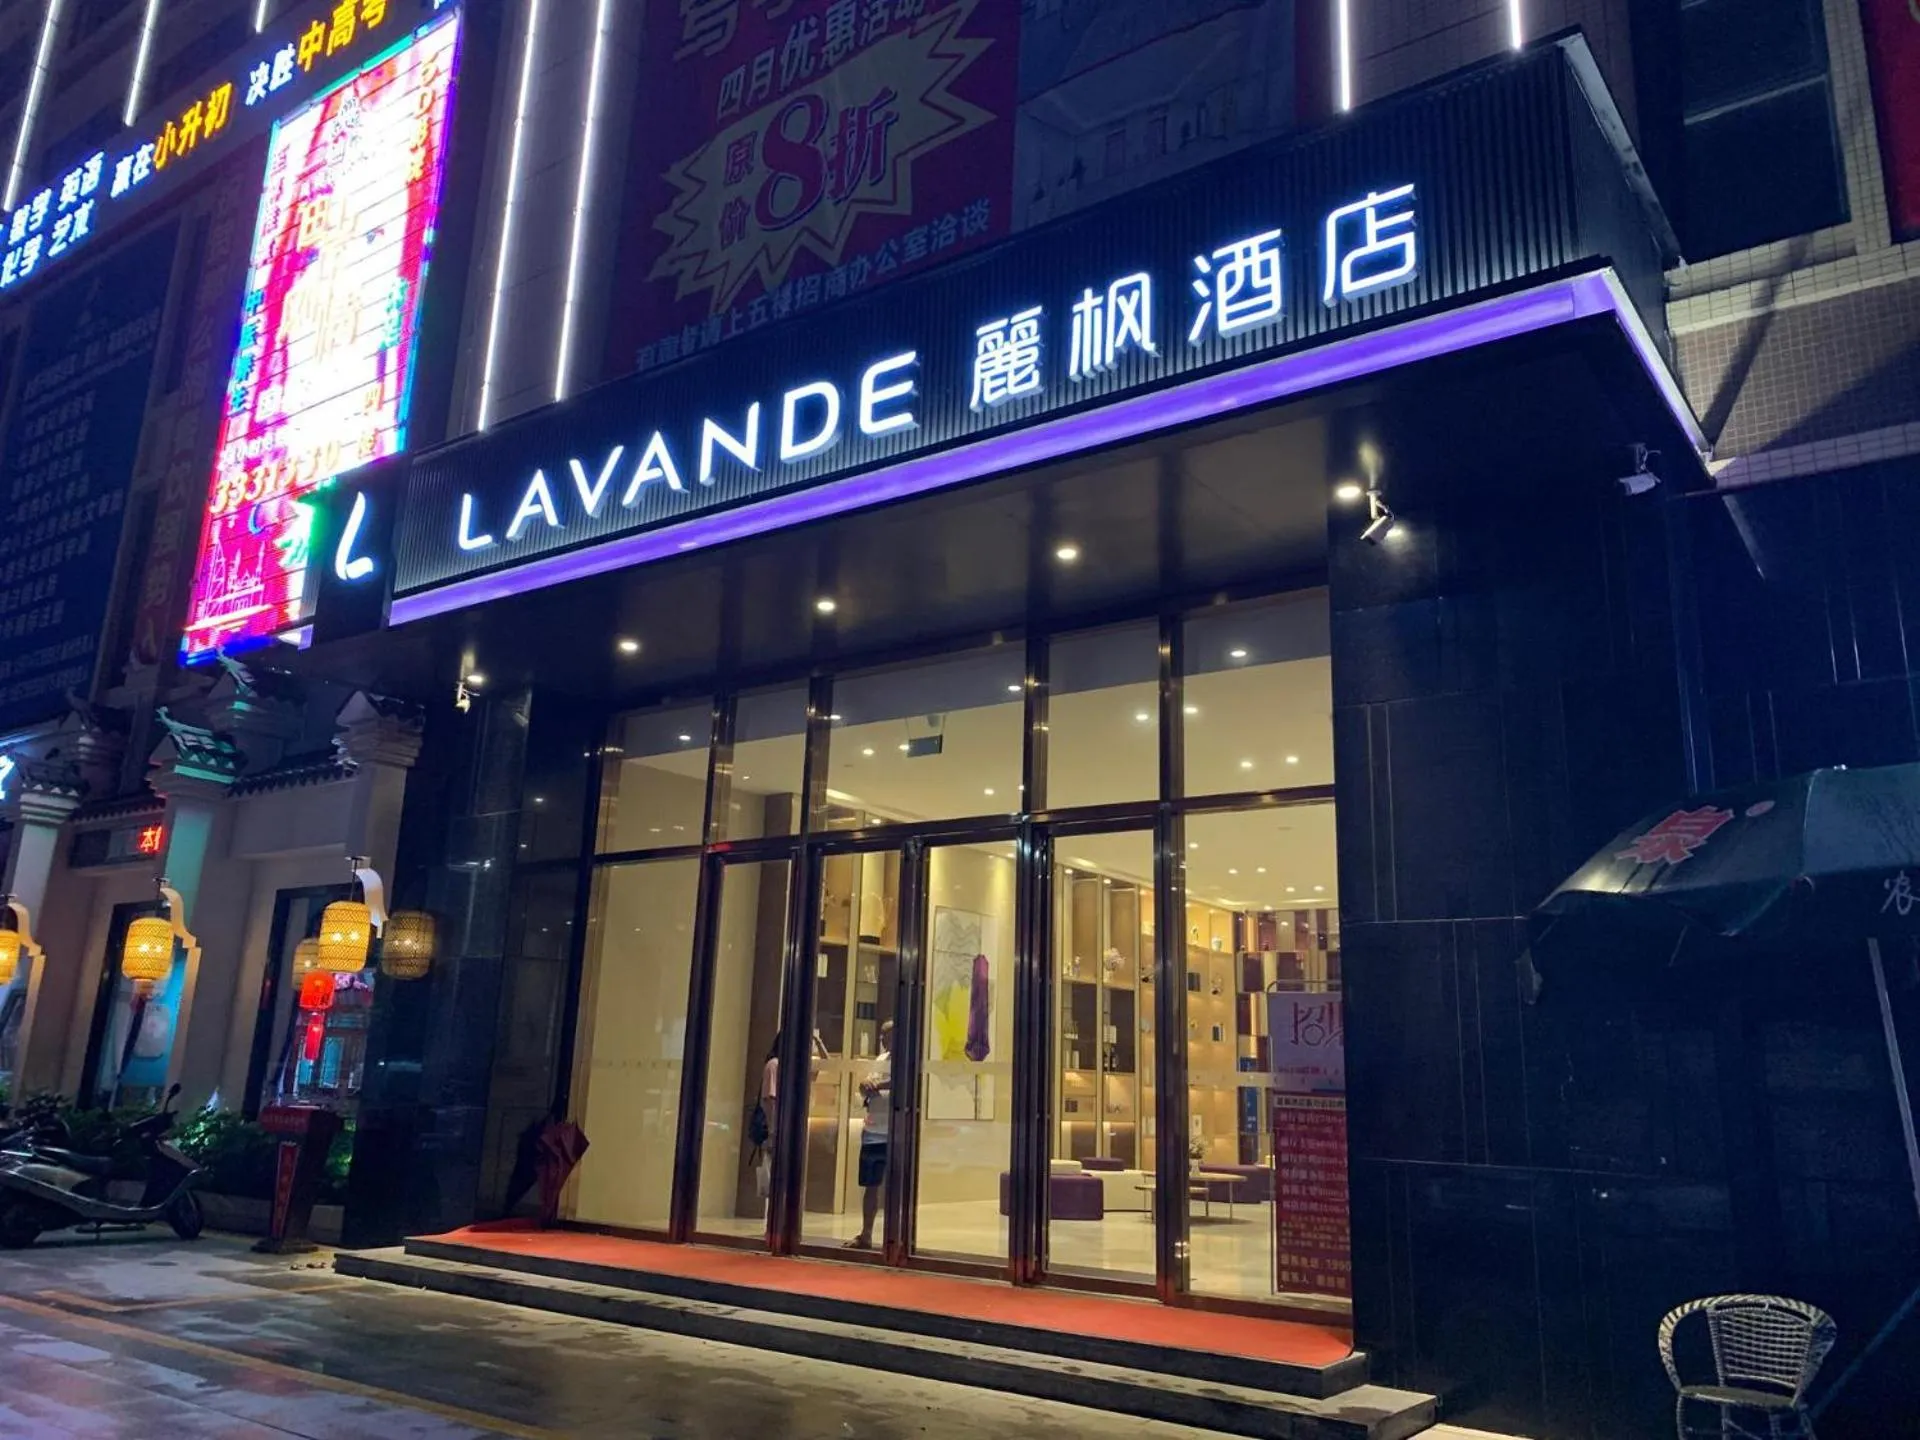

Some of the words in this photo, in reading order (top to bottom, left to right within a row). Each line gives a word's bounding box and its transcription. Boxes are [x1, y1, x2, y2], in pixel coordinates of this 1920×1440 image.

[457, 350, 920, 550] LAVANDE
[969, 184, 1416, 411] 麗枫酒店
